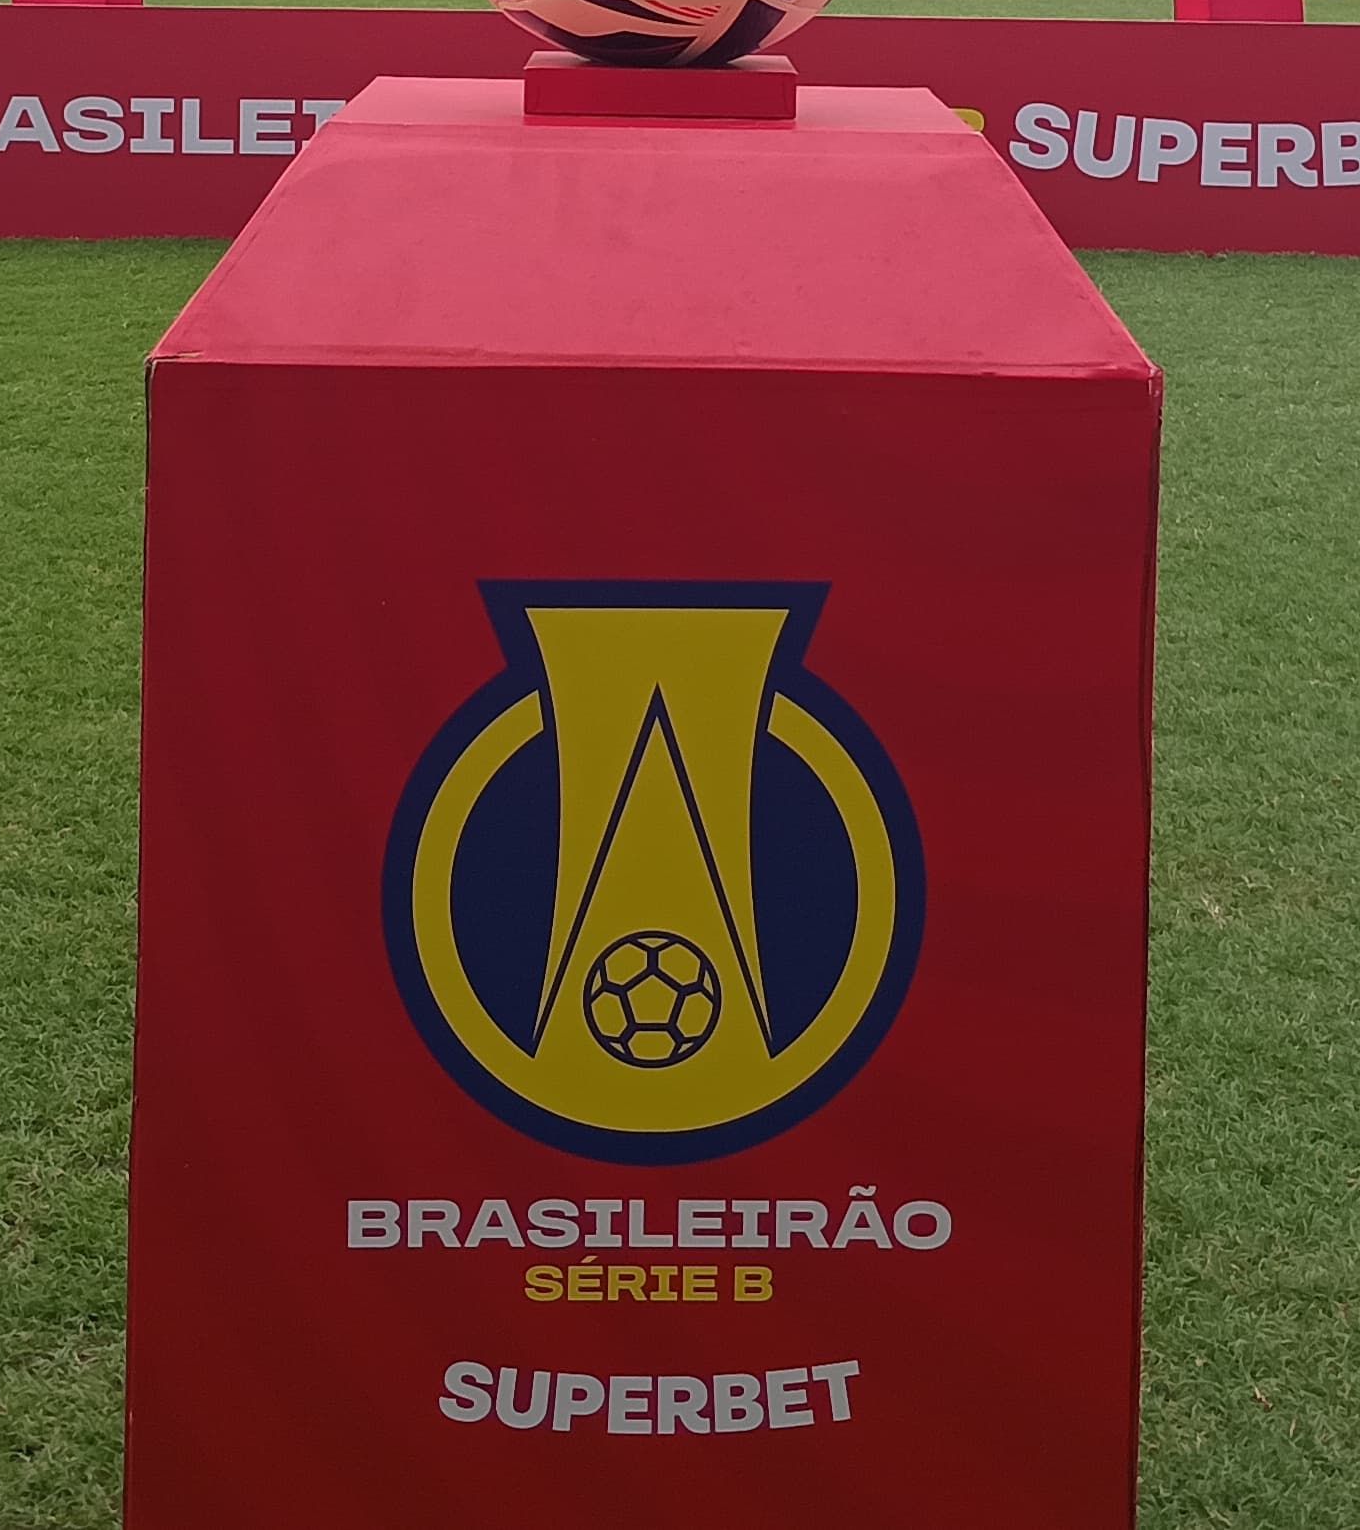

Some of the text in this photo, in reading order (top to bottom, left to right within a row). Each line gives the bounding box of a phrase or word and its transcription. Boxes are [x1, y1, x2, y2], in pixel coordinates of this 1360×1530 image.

[347, 1185, 952, 1250] BRASILEIRÃO
[524, 1256, 774, 1302] SÉRIE B
[439, 1360, 860, 1435] SUPERBET
